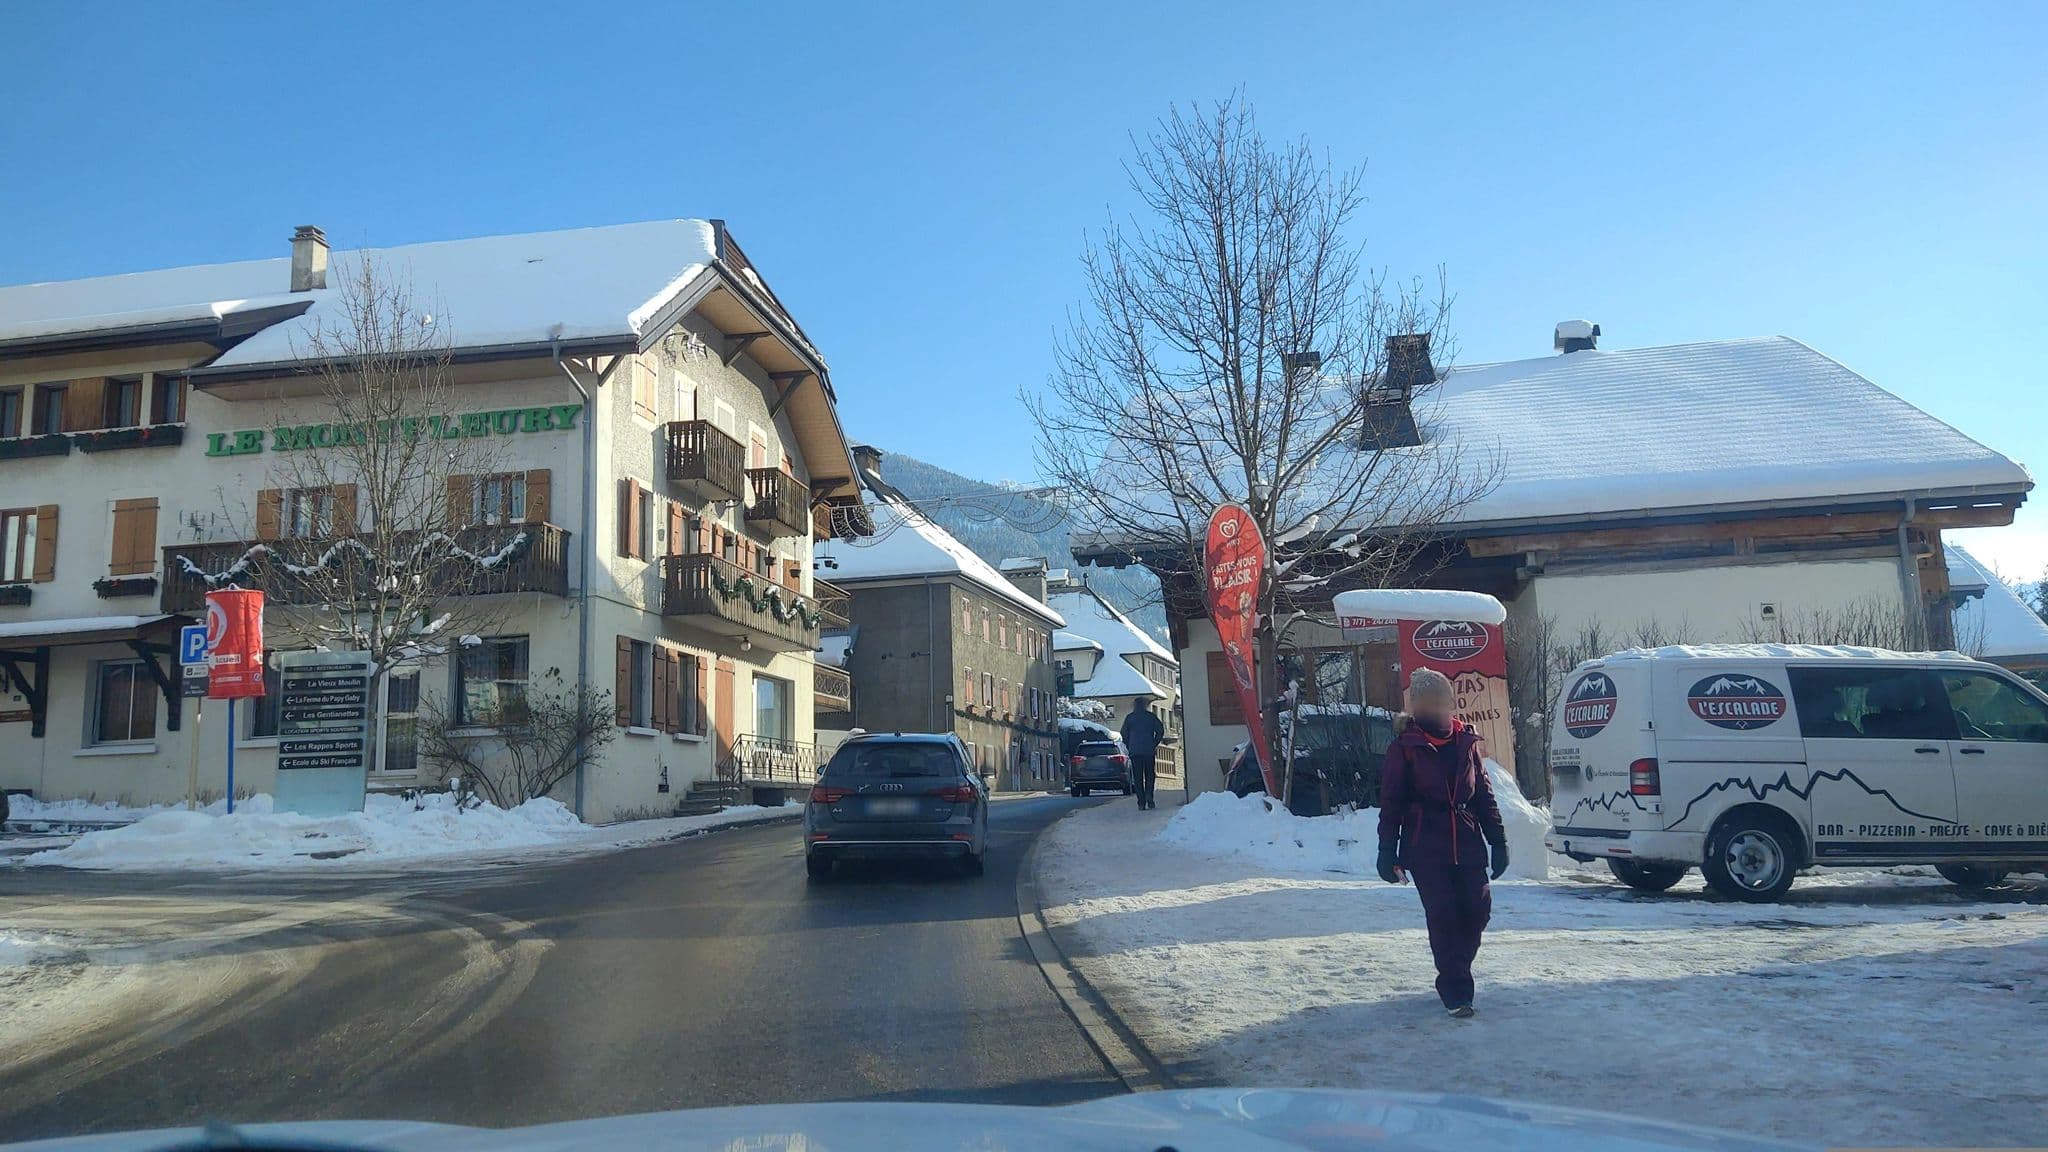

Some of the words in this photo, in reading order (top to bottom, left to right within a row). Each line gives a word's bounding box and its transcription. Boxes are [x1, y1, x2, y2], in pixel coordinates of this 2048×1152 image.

[207, 430, 264, 457] LE
[189, 633, 206, 657] P
[1426, 638, 1476, 648] L'ESCALADE
[1452, 678, 1485, 694] ZAS
[1566, 704, 1610, 723] L'ESCALADE
[1698, 701, 1779, 716] L'ESCALADE
[335, 742, 358, 750] Sports
[320, 758, 329, 766] Ski
[1818, 824, 1844, 836] BAR
[1859, 824, 1915, 837] PIZZERIA
[1930, 824, 1969, 837] PRESSE
[1984, 825, 2013, 837] CAVE
[2028, 822, 2048, 837] BIÈ
